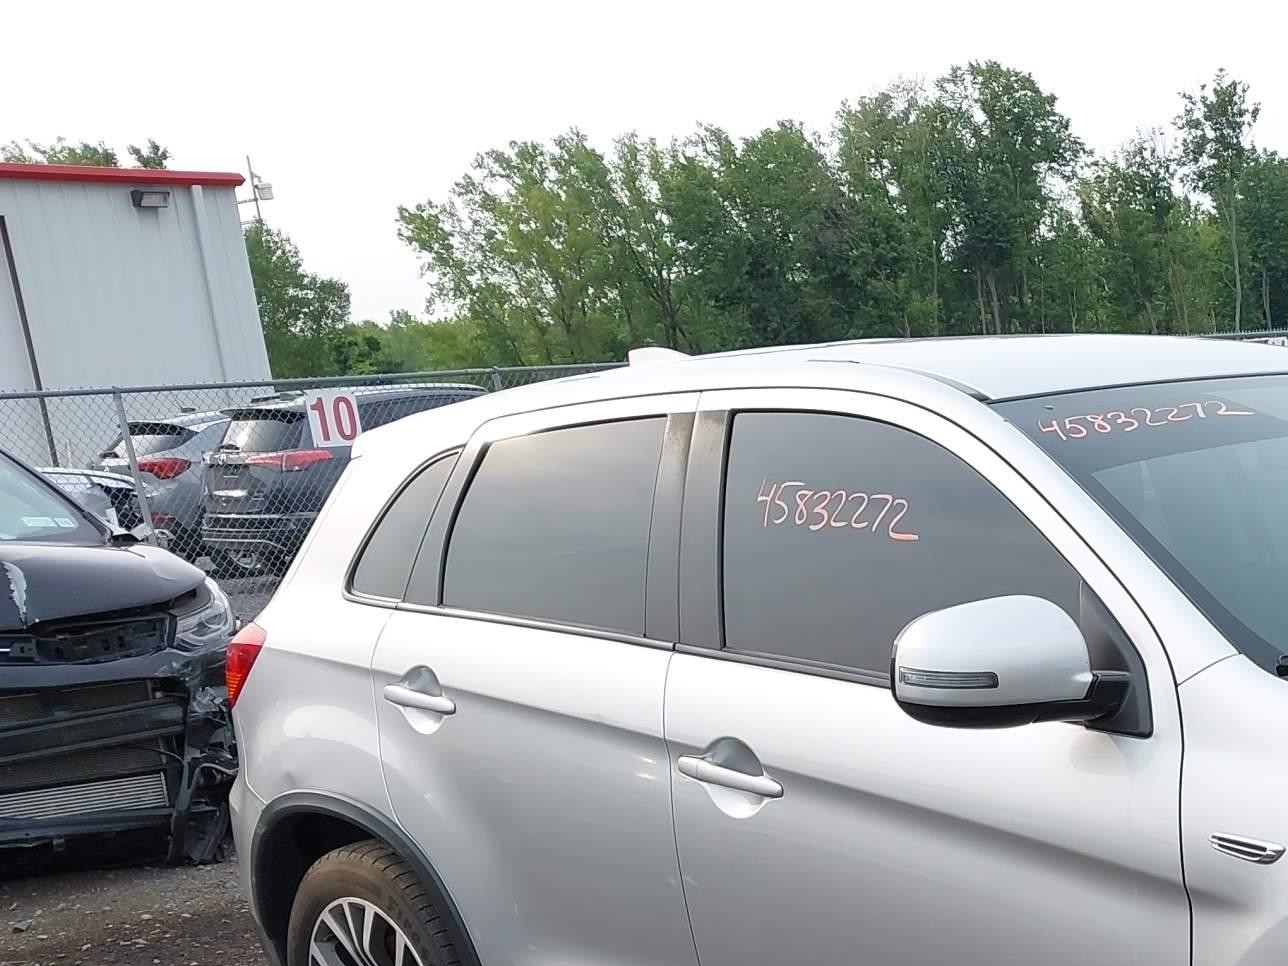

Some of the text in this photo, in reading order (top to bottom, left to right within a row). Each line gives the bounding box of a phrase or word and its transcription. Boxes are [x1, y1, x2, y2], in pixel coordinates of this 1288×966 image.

[310, 396, 357, 441] 10
[1037, 400, 1256, 441] 45832272
[757, 476, 919, 541] 45832272
